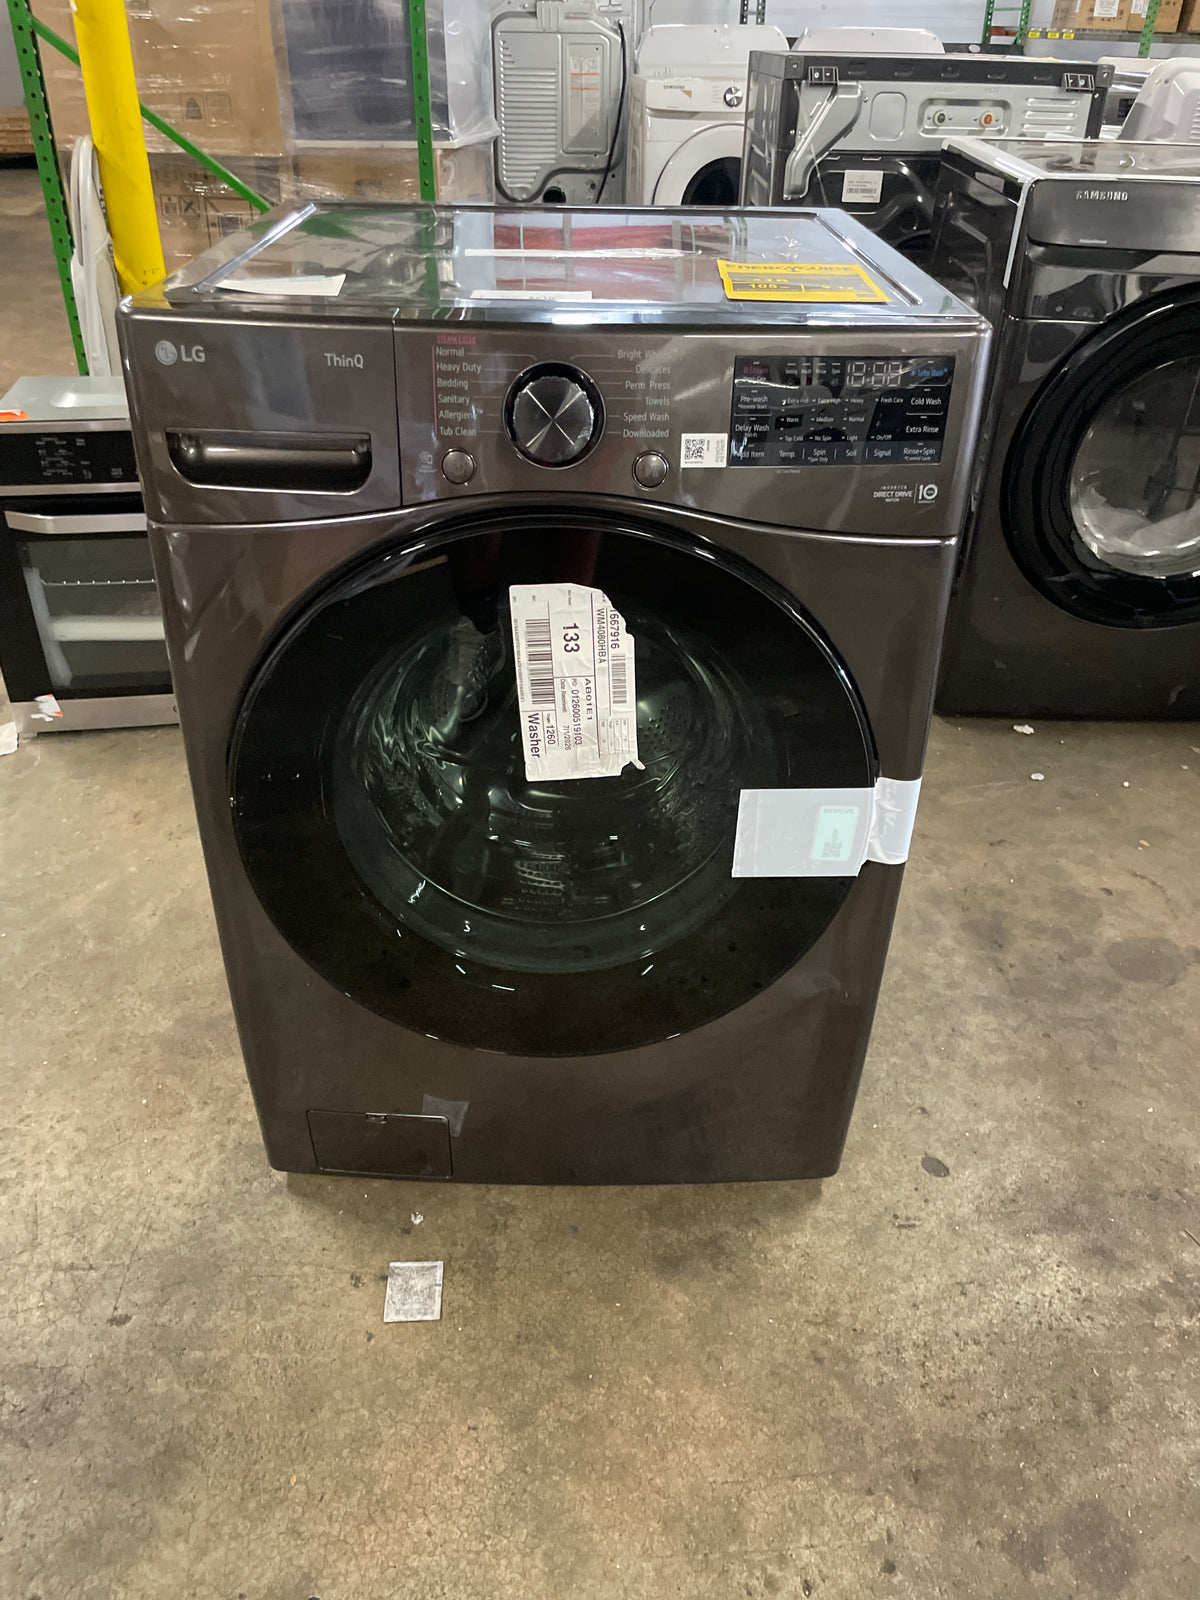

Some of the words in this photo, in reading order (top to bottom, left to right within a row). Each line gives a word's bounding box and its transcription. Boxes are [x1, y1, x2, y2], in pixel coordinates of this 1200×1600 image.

[1075, 190, 1129, 201] SAMSUNG
[180, 344, 206, 363] LG
[435, 346, 465, 357] Normal
[617, 349, 641, 361] Bright
[324, 353, 365, 370] ThinQ
[436, 361, 461, 374] Heavy
[462, 361, 481, 375] Duty
[635, 364, 672, 375] Delicates
[437, 377, 469, 391] Bedding
[650, 380, 671, 391] Press
[437, 394, 470, 406] Sanitary
[645, 396, 671, 407] Towels
[910, 397, 925, 405] Cold
[925, 397, 942, 405] Wash
[623, 412, 647, 423] Speed
[649, 412, 670, 422] Wash
[440, 426, 453, 436] Tub
[454, 426, 477, 437] Clean
[735, 423, 752, 432] Delay
[753, 423, 770, 432] Wash
[905, 425, 921, 433] Extra
[922, 425, 940, 433] Rinse
[623, 428, 670, 439] Downloaded
[750, 450, 765, 458] Item
[813, 448, 827, 457] Spin
[845, 449, 857, 457] Soil
[873, 449, 892, 458] Signal
[903, 447, 936, 456] Rinse+Spin
[918, 484, 938, 500] 10
[563, 622, 580, 654] 133
[596, 608, 607, 664] WM4080HBA
[585, 678, 593, 720] AB01E1
[571, 689, 583, 746] 012600519103
[527, 712, 541, 759] Washer
[547, 725, 556, 745] 1260
